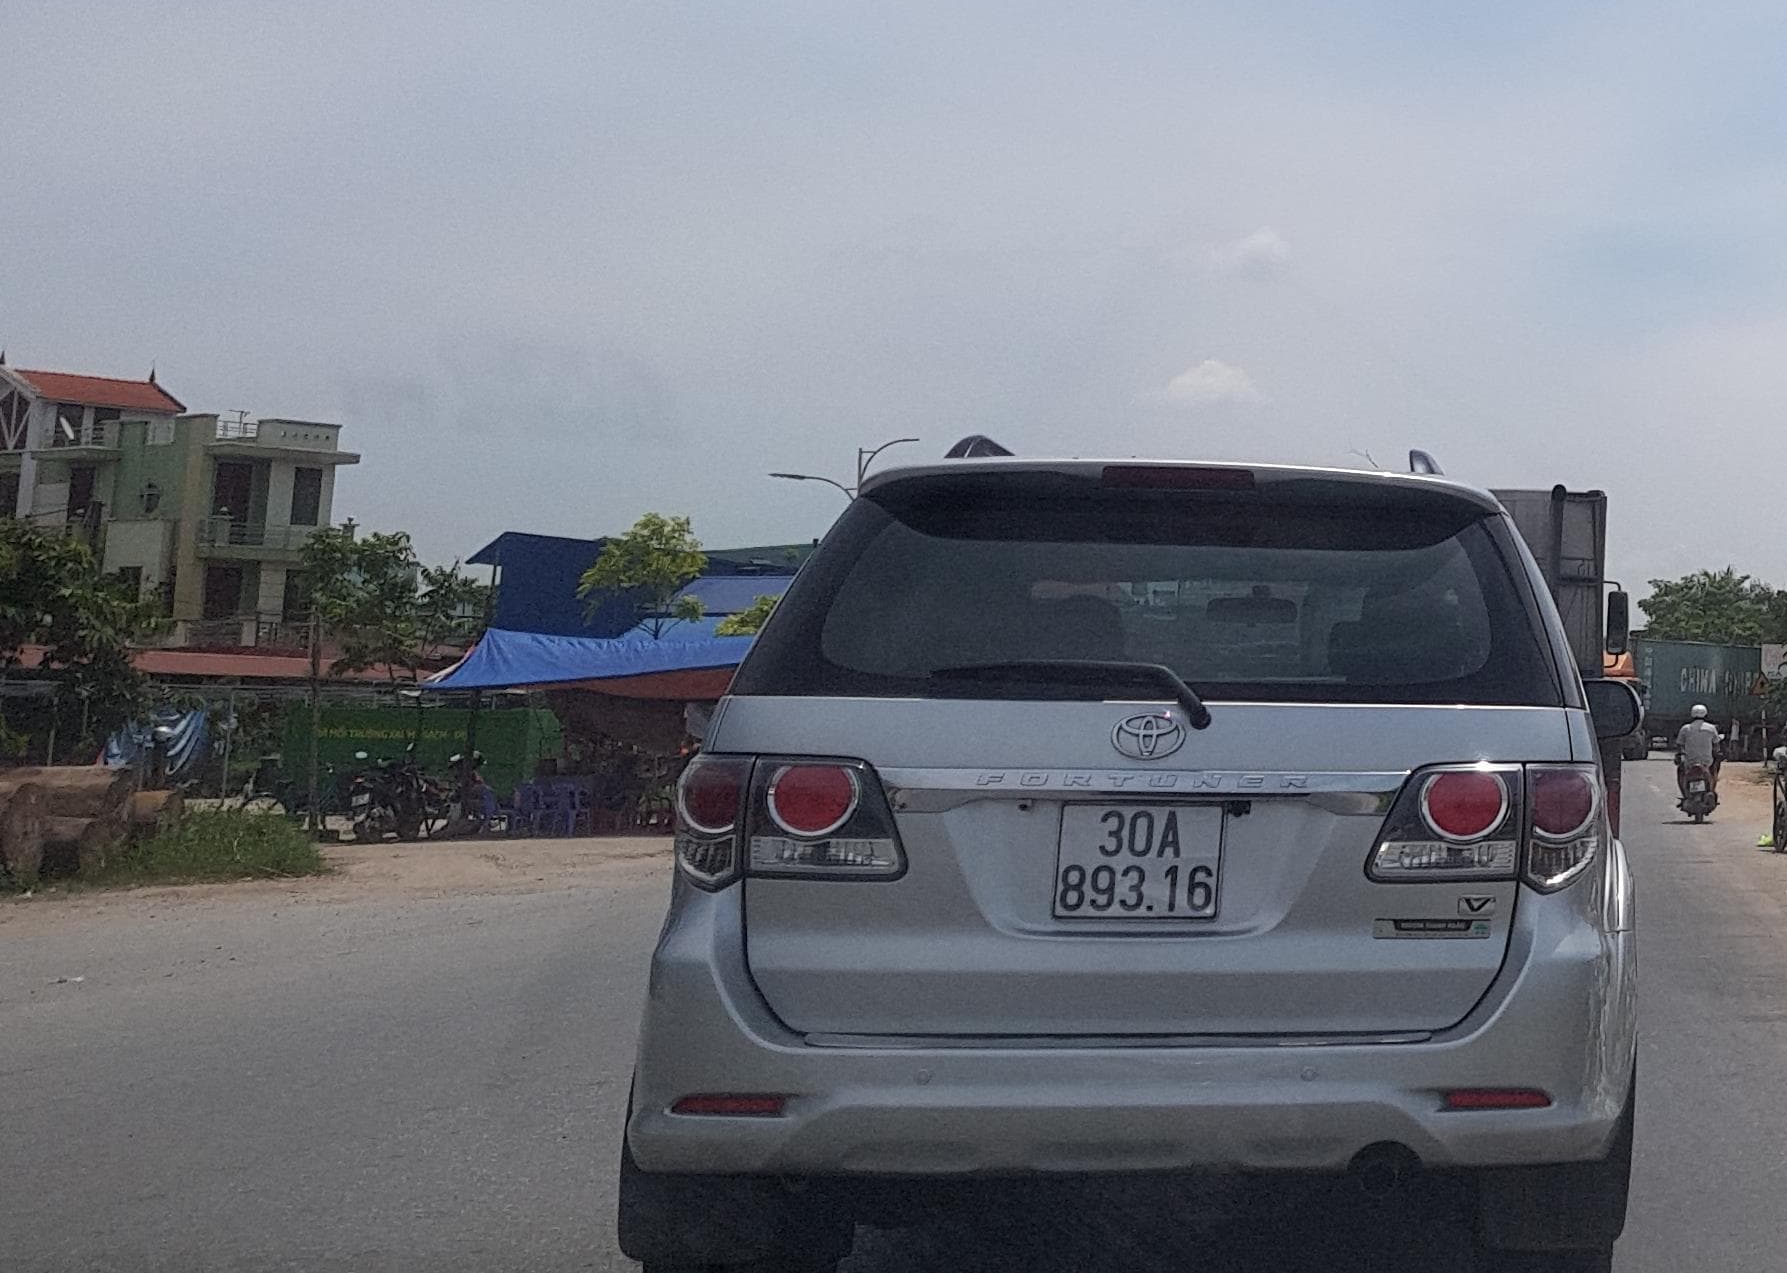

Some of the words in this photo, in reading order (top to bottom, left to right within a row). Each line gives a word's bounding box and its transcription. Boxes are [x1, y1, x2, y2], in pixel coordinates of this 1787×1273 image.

[1680, 666, 1717, 695] CHINA
[975, 772, 1309, 789] FORTUNER
[1098, 809, 1182, 859] 30A
[1059, 864, 1214, 913] 893.16
